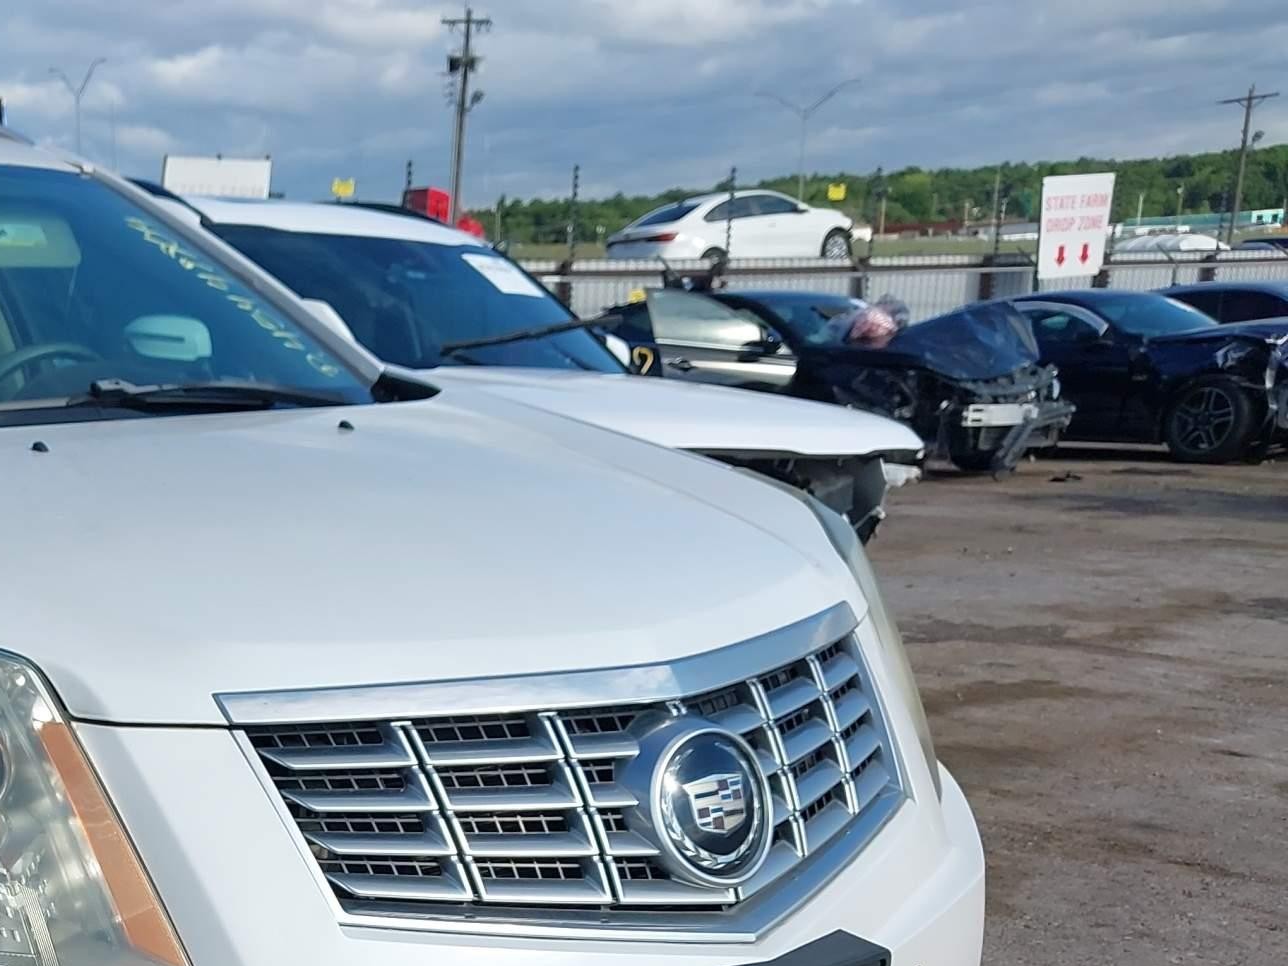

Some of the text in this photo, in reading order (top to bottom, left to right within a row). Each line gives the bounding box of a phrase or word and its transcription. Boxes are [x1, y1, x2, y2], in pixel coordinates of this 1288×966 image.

[1045, 192, 1109, 211] STATE FARM
[1045, 215, 1104, 232] DROP ZONE
